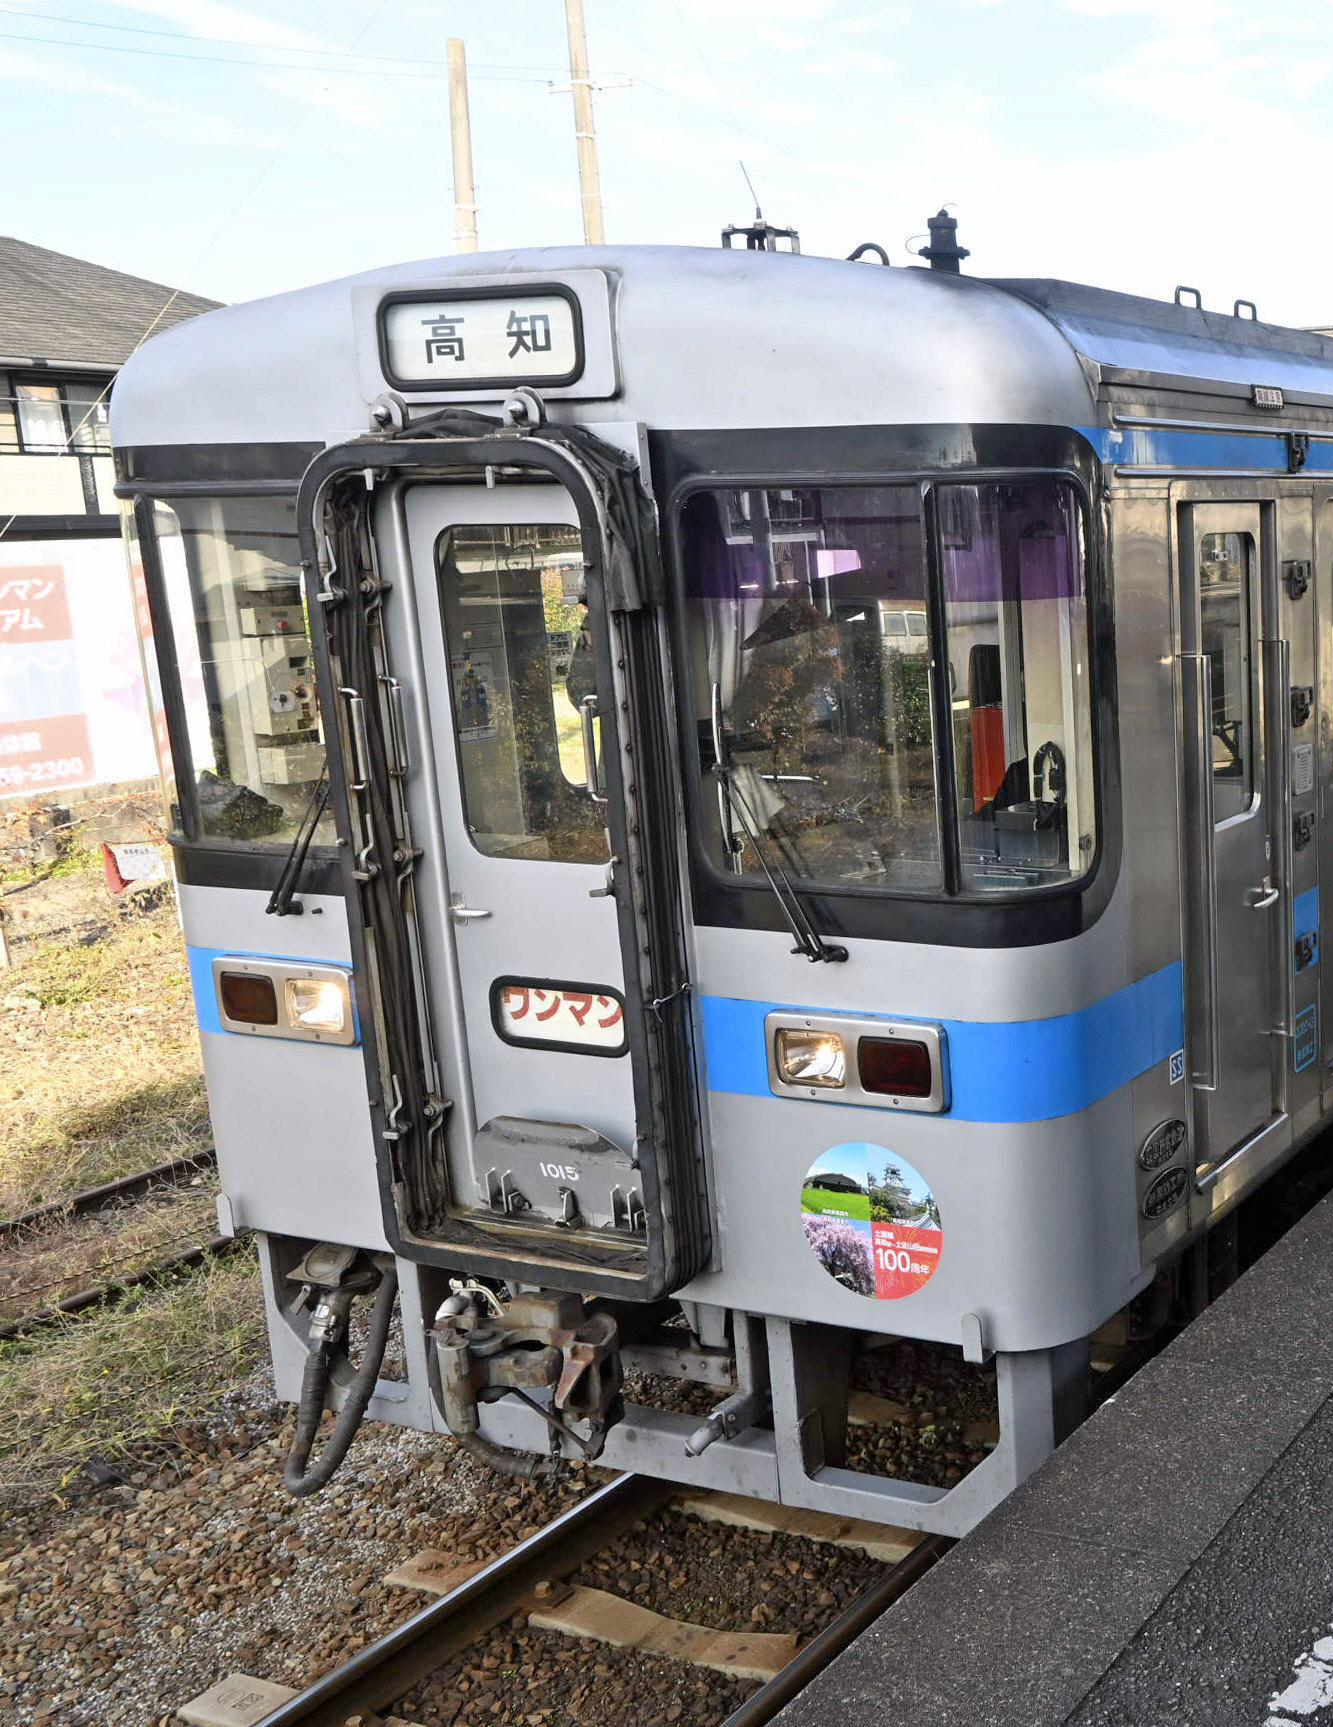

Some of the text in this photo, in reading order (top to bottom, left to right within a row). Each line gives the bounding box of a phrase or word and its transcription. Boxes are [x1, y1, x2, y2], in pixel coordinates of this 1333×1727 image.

[420, 309, 552, 364] 高知
[503, 986, 622, 1028] ワンマン
[539, 1162, 580, 1181] 1015
[876, 1247, 931, 1276] 100周年
